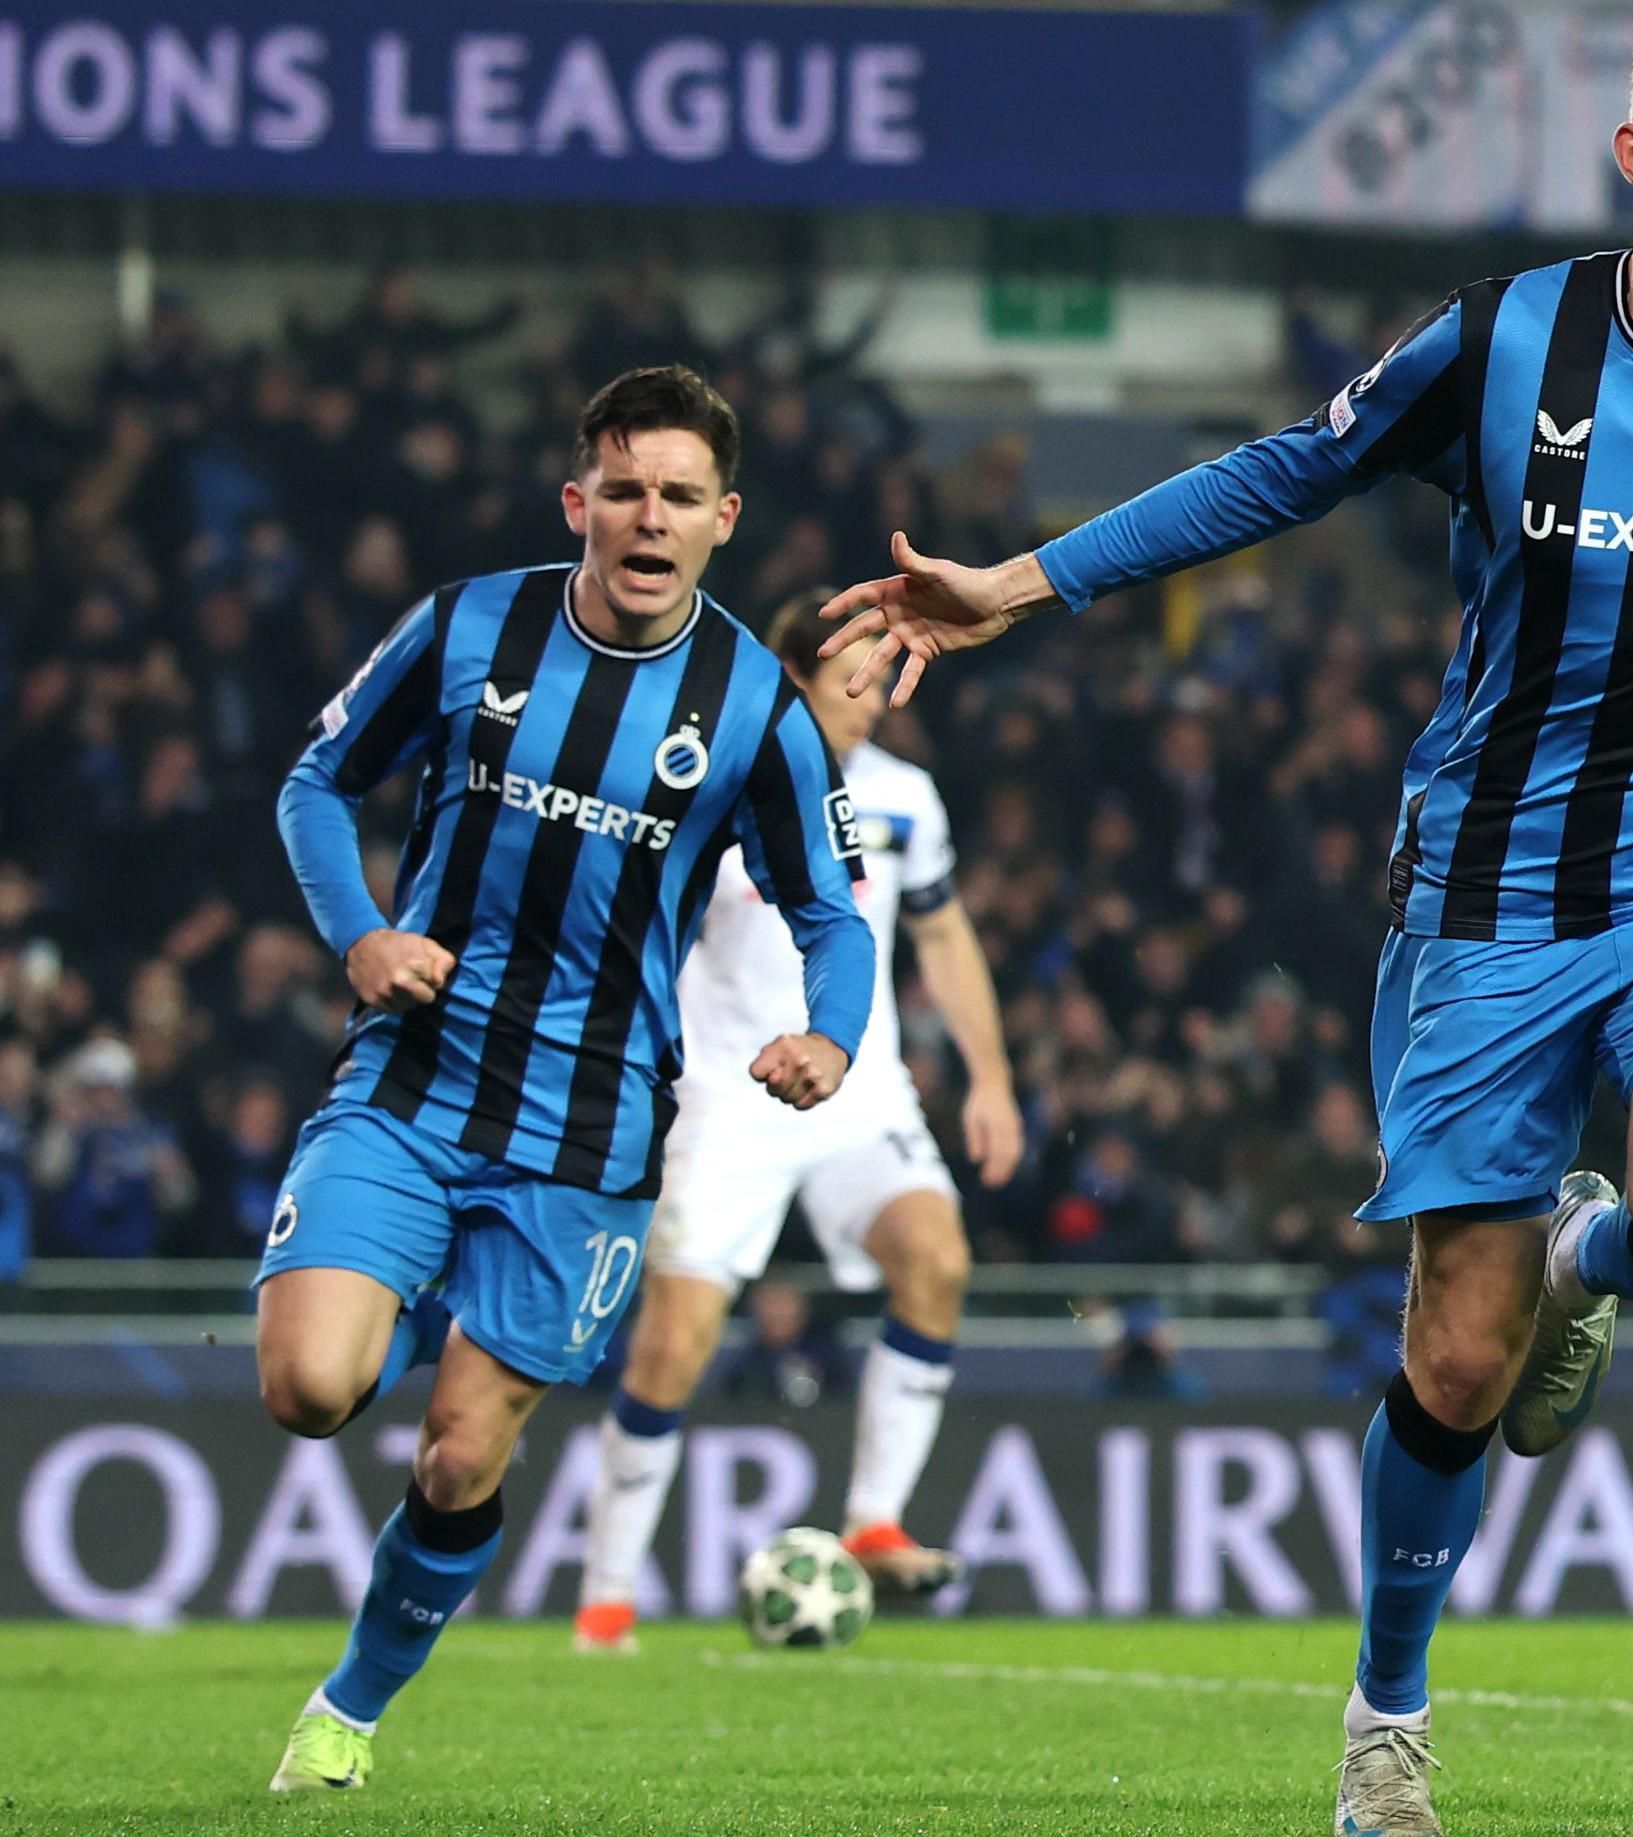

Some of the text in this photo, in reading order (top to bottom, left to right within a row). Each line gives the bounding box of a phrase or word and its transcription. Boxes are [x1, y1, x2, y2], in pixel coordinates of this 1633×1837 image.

[371, 31, 923, 163] LEAGUE
[1534, 444, 1585, 460] CASTORE
[468, 758, 677, 850] U-EXPERTS
[578, 1230, 638, 1318] 10
[1393, 1547, 1450, 1568] FCB
